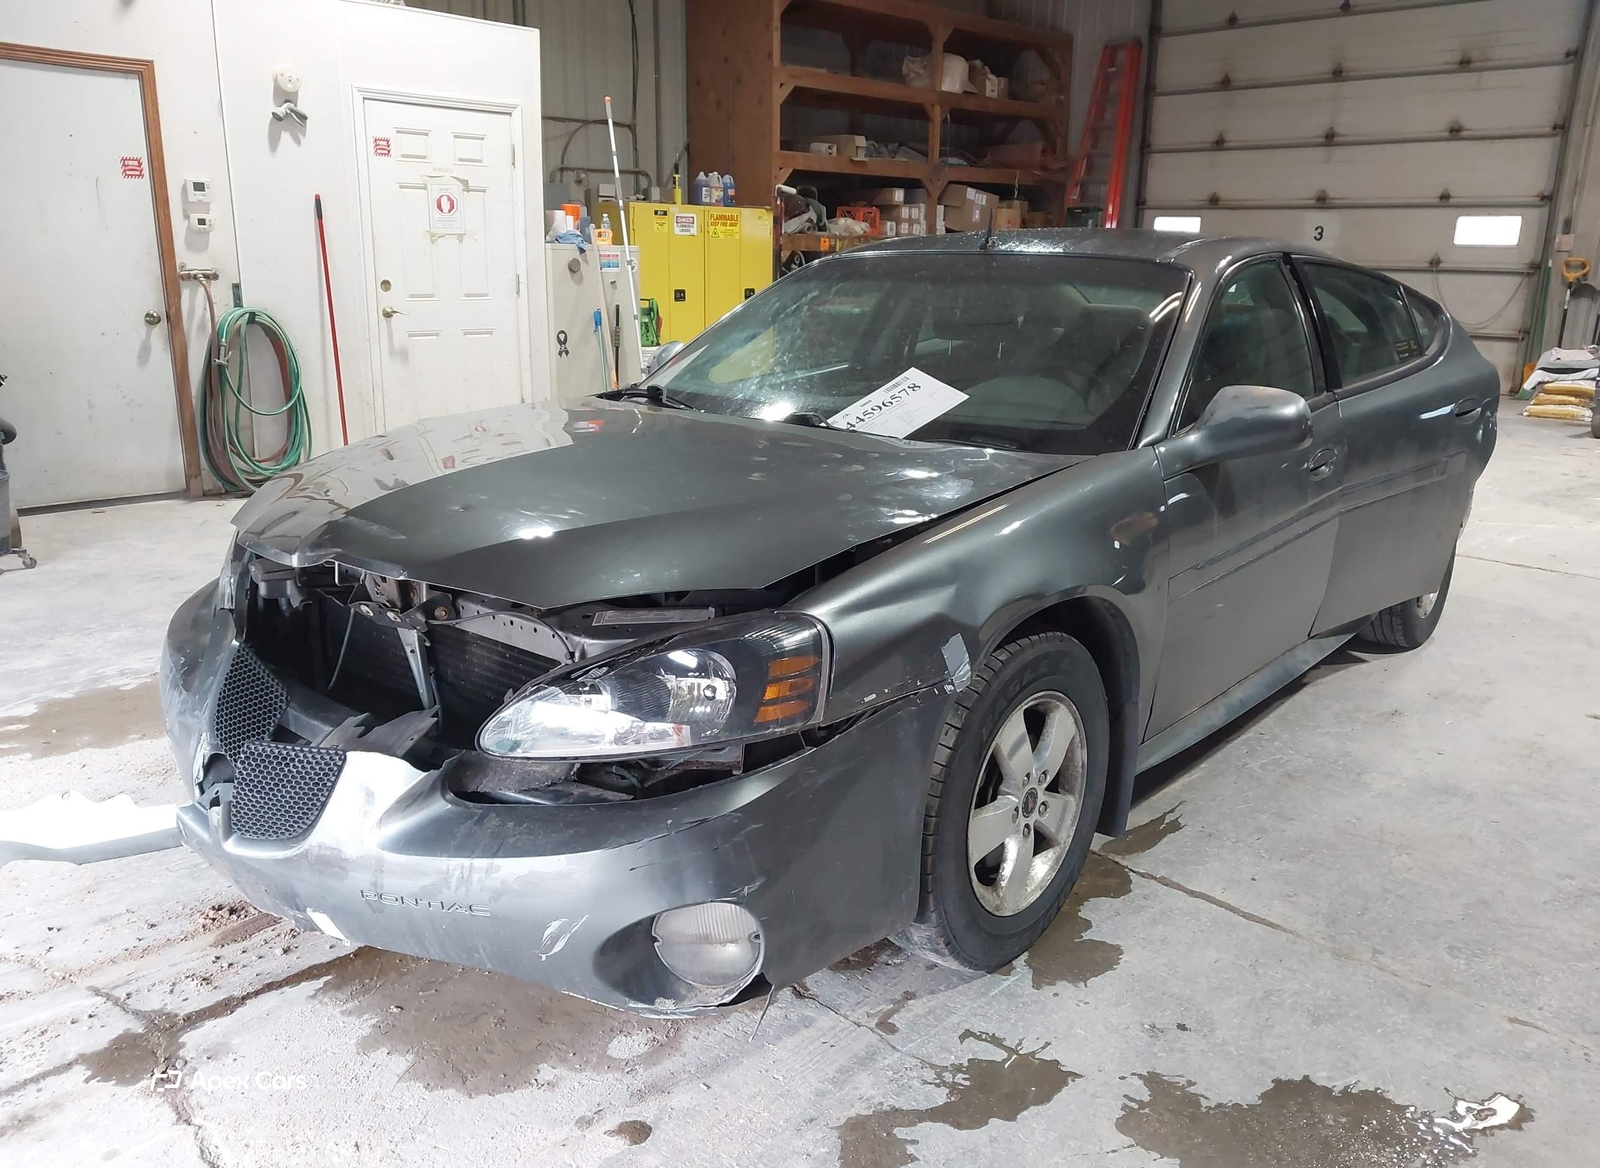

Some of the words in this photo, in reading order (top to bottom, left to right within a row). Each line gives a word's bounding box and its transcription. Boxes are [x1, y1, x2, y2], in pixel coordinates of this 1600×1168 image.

[710, 213, 739, 221] FLAMMABLE
[1313, 225, 1324, 241] 3
[845, 382, 922, 431] 44596578
[360, 889, 492, 917] PONTIAC
